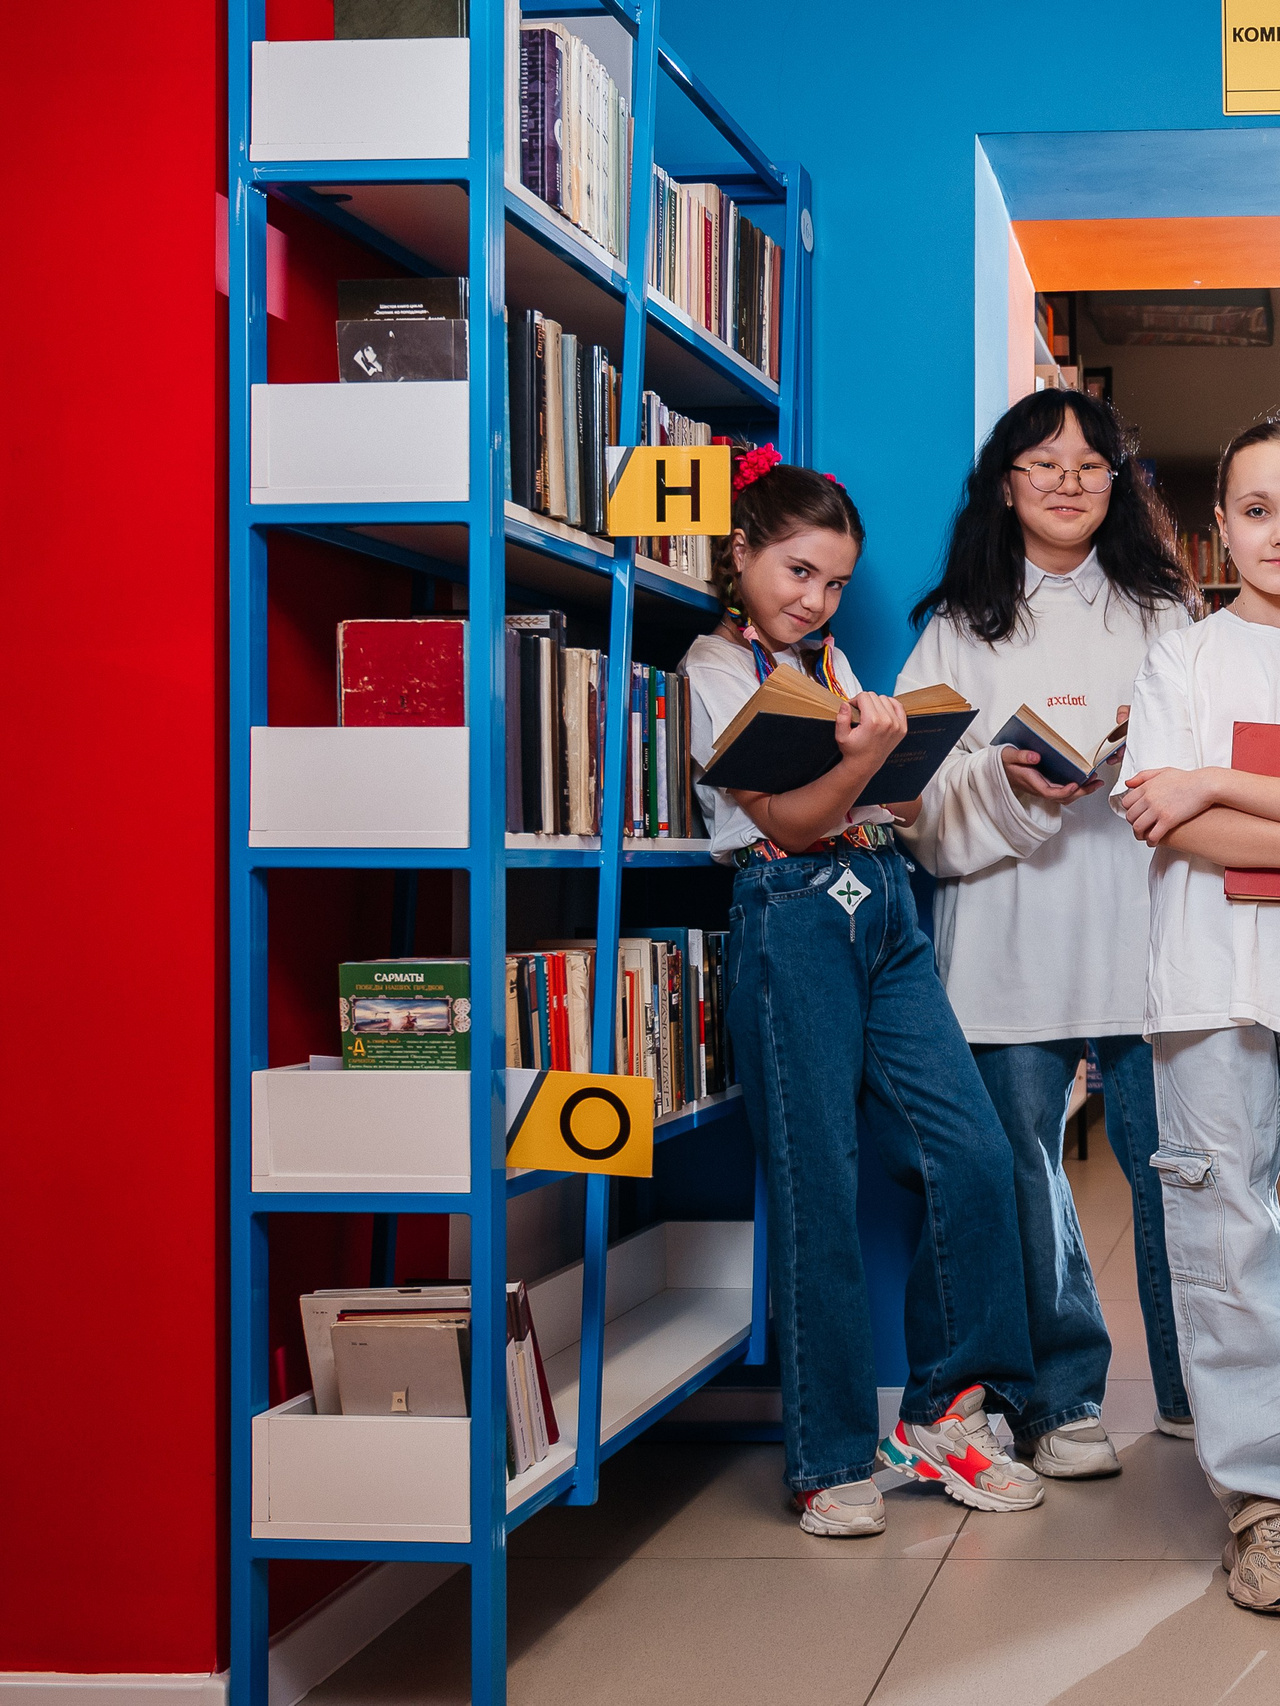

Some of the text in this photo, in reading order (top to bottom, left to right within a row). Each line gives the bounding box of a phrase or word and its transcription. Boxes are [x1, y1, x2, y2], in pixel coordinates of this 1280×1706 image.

[656, 459, 700, 523] Н
[374, 972, 425, 983] САРМАТЫ
[660, 950, 670, 1095] БУЛАТ ОКУДЖАВА
[560, 1087, 631, 1160] О
